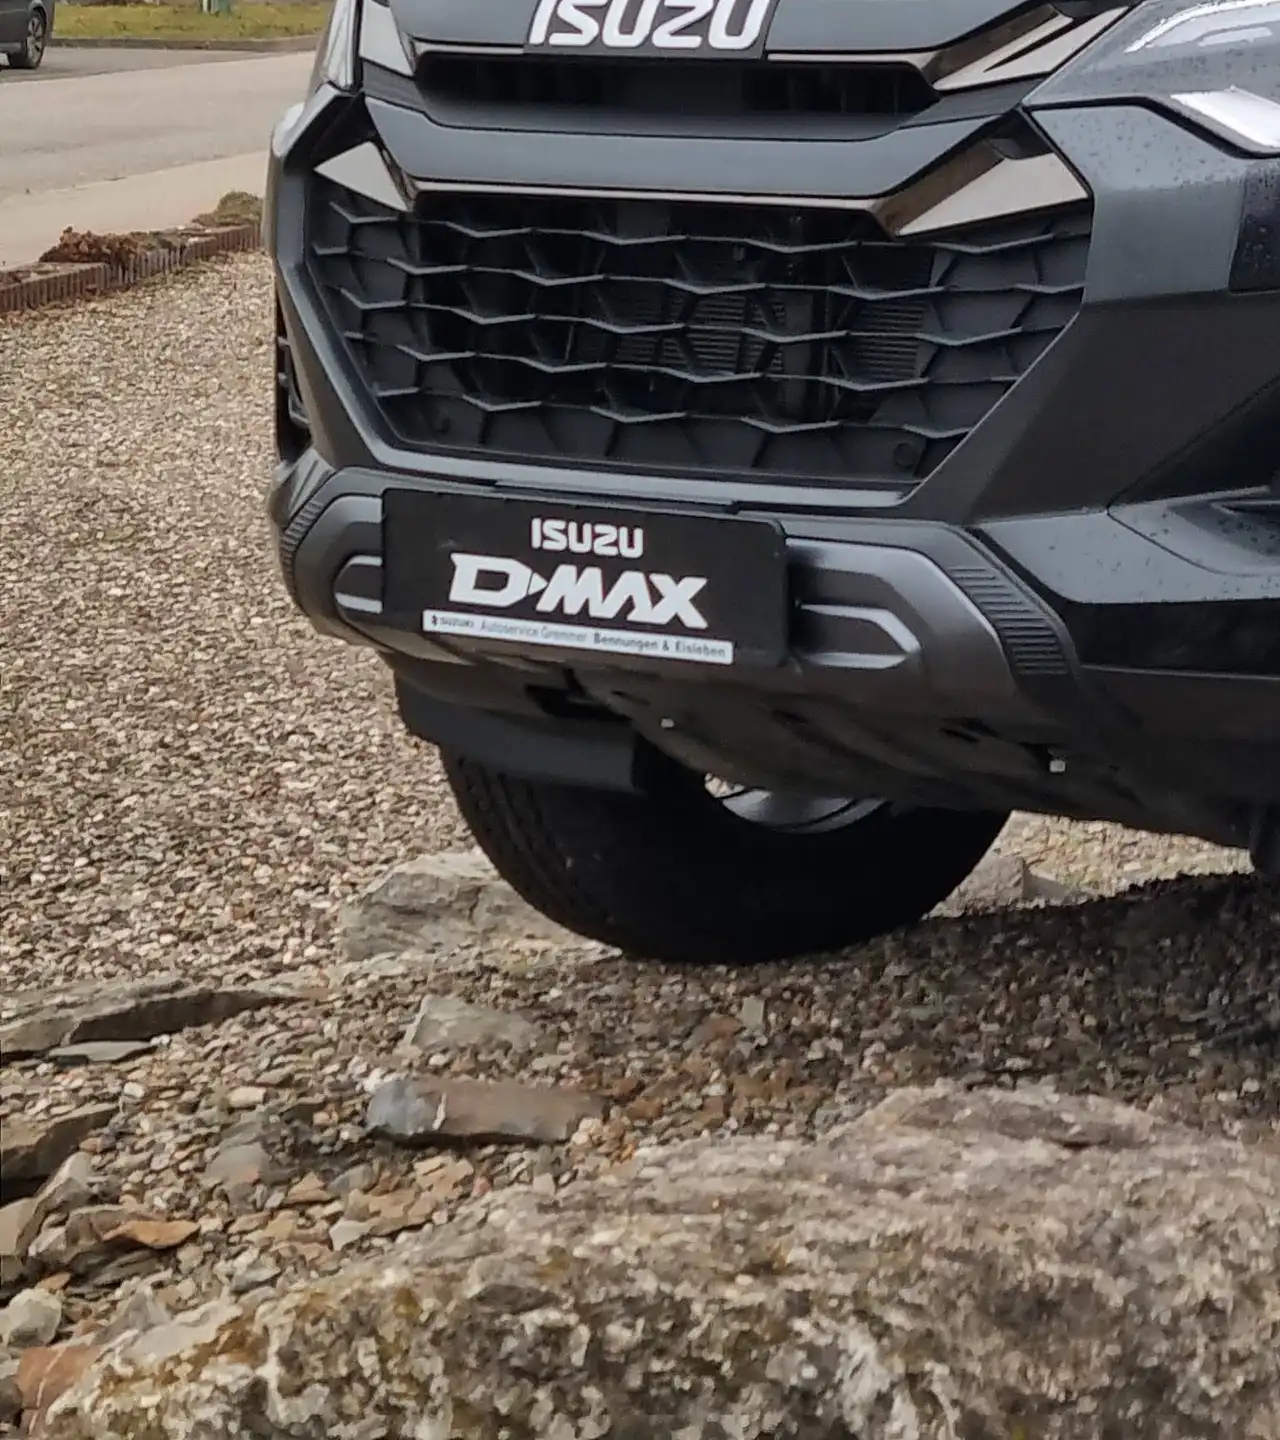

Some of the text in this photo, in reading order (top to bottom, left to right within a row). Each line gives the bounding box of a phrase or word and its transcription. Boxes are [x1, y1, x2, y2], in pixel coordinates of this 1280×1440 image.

[531, 517, 644, 558] ISUZU
[448, 552, 709, 629] D-MAX
[662, 640, 670, 652] &
[674, 640, 727, 658] Eisleben
